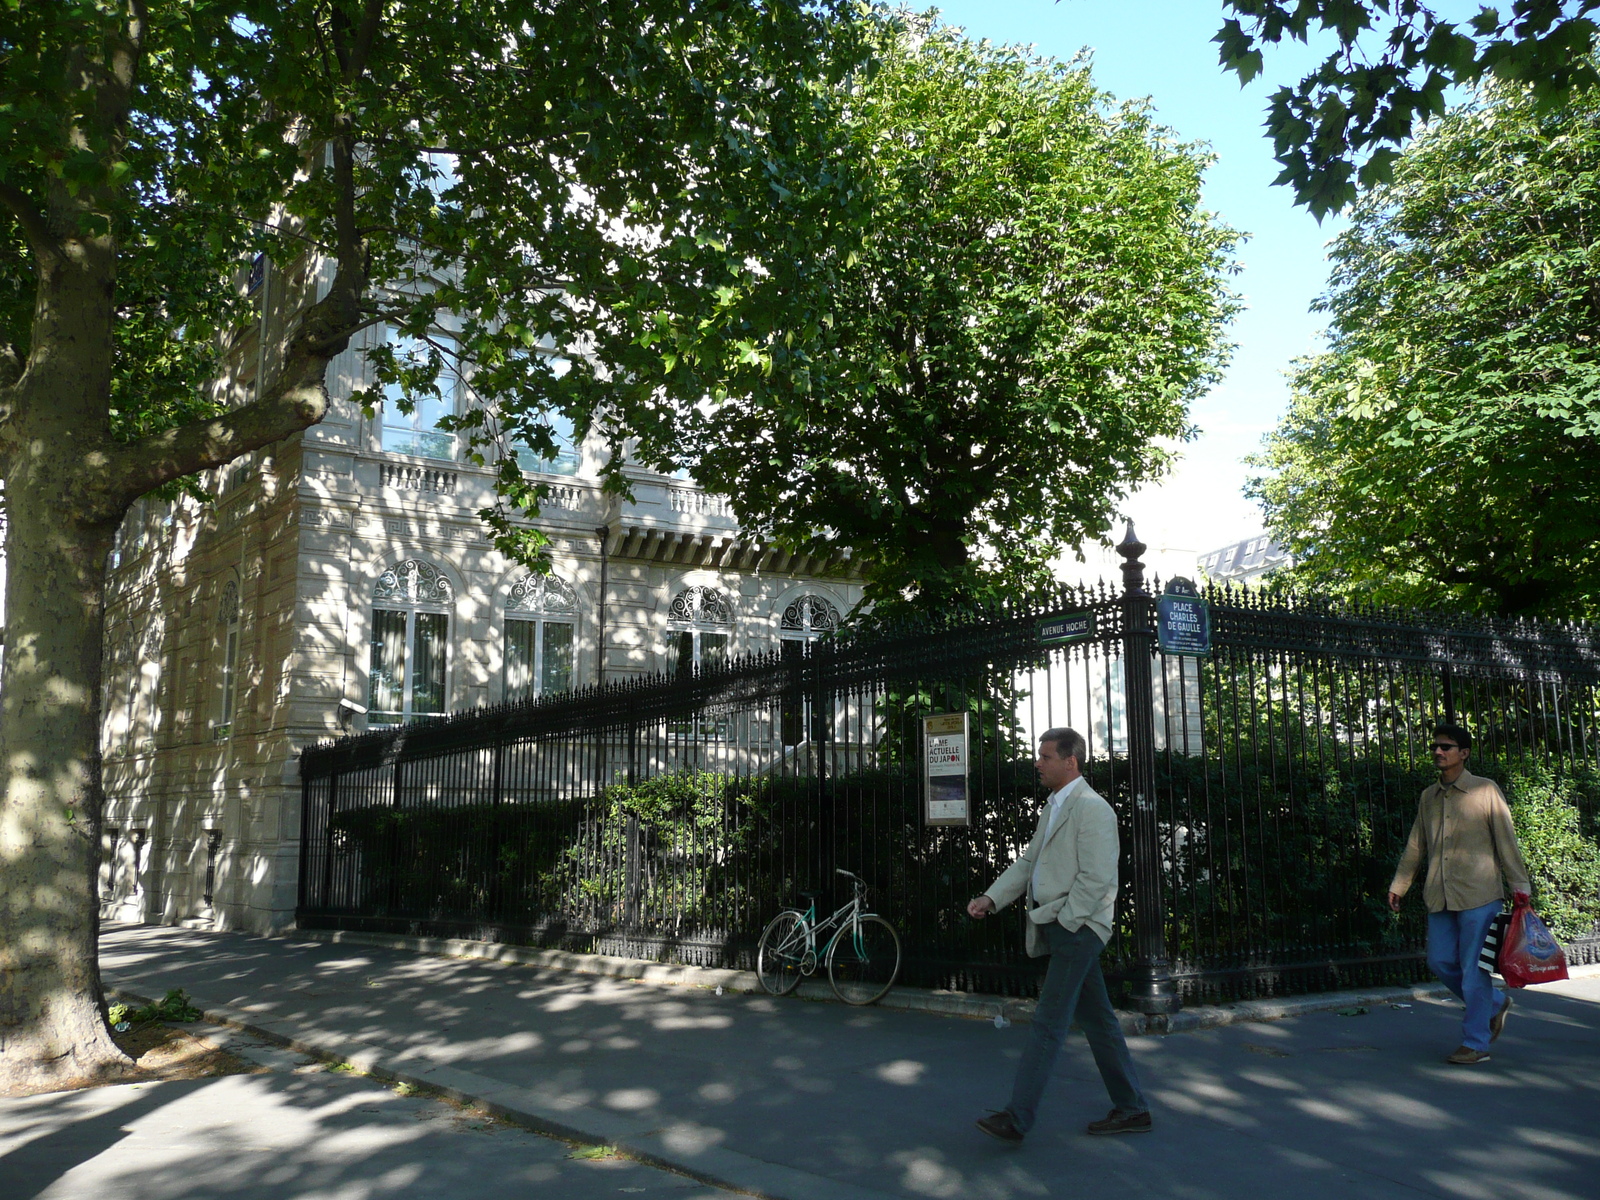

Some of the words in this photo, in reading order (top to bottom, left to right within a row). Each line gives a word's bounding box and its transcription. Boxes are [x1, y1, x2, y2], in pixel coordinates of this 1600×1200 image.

[1173, 602, 1193, 613] PLACE
[1169, 611, 1198, 623] CHARLES
[1041, 622, 1065, 636] AVENUE
[1066, 620, 1088, 632] HOCHE
[1167, 621, 1176, 631] DE
[1177, 622, 1202, 633] GAULLE
[929, 746, 960, 756] ACTUELLE
[929, 756, 938, 764] DU
[939, 754, 960, 763] JAPON
[1527, 963, 1546, 973] Disney
